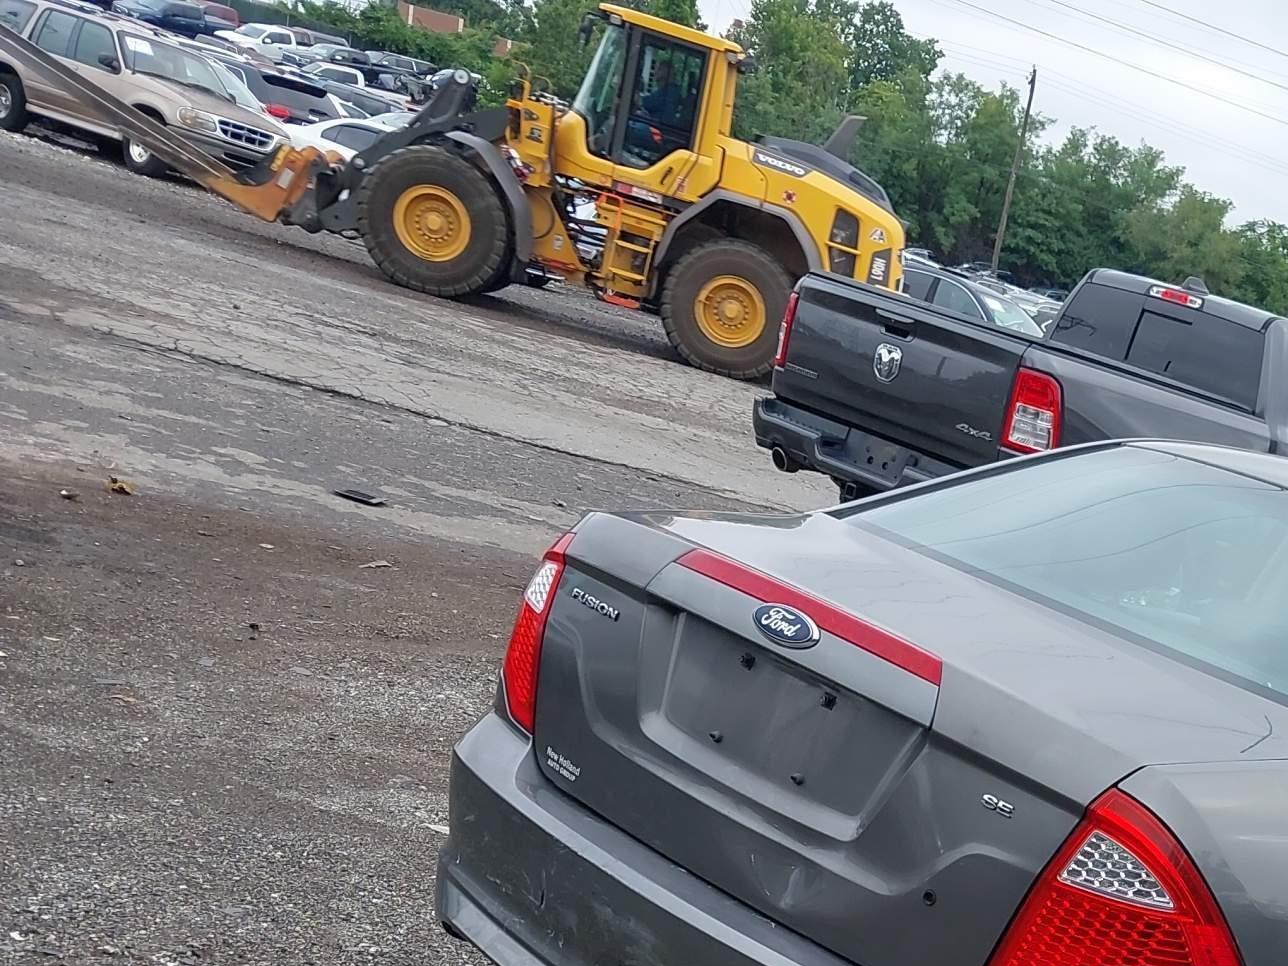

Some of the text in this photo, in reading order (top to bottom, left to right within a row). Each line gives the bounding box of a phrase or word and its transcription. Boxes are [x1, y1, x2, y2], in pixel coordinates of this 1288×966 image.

[756, 153, 806, 176] VOLVO
[870, 257, 887, 281] L90H
[571, 587, 620, 621] FUSION
[761, 607, 801, 637] Ford
[547, 746, 581, 777] New Holland
[981, 794, 1014, 818] SE
